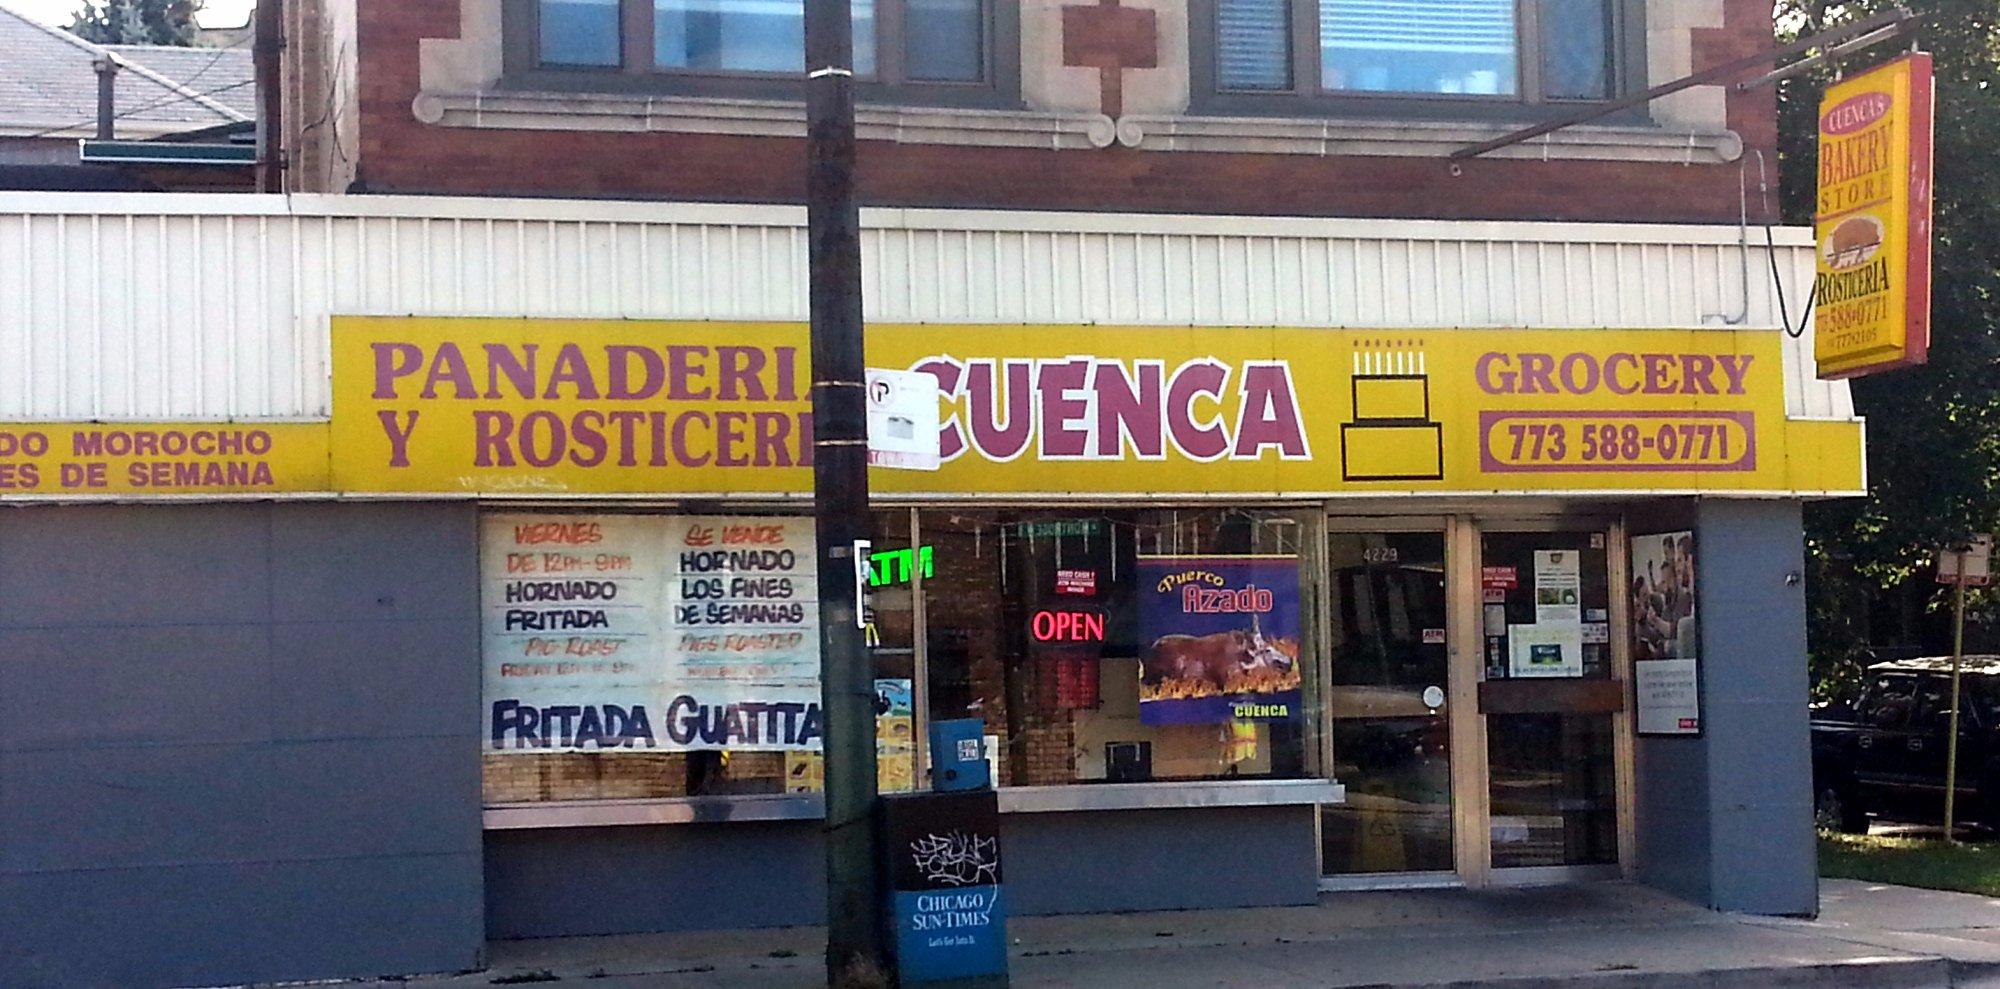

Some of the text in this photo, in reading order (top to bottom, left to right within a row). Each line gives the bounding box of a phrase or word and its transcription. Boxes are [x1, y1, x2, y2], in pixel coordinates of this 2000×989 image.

[1820, 118, 1893, 188] BAKERY
[1820, 173, 1890, 214] STORE
[1816, 256, 1890, 307] ROSTICERIA
[1474, 351, 1755, 395] GROCERY
[371, 341, 1313, 463] PANADERI CUENCA
[0, 430, 272, 456] DO MOROCHO
[377, 410, 814, 468] Y ROSTICERI
[1508, 424, 1729, 461] 773 588-0771
[0, 461, 275, 488] ES DE SEMANA
[684, 524, 785, 546] SE VENDE
[507, 553, 537, 573] DE
[680, 549, 796, 572] HORNADO
[869, 545, 934, 586] TM
[1363, 547, 1399, 562] 4229
[505, 581, 617, 603] HORNADO
[682, 577, 793, 599] LOS FINES
[1157, 570, 1225, 593] Puerco
[1182, 583, 1273, 613] Azado
[505, 609, 609, 631] FRITADA
[674, 602, 804, 625] DE SEMANAS
[1033, 611, 1104, 641] OPEN
[492, 695, 824, 749] FRITADA GUATITA
[1234, 704, 1288, 717] CUENCA
[917, 893, 984, 913] CHICAGO
[912, 910, 990, 931] SUN-TIMES
